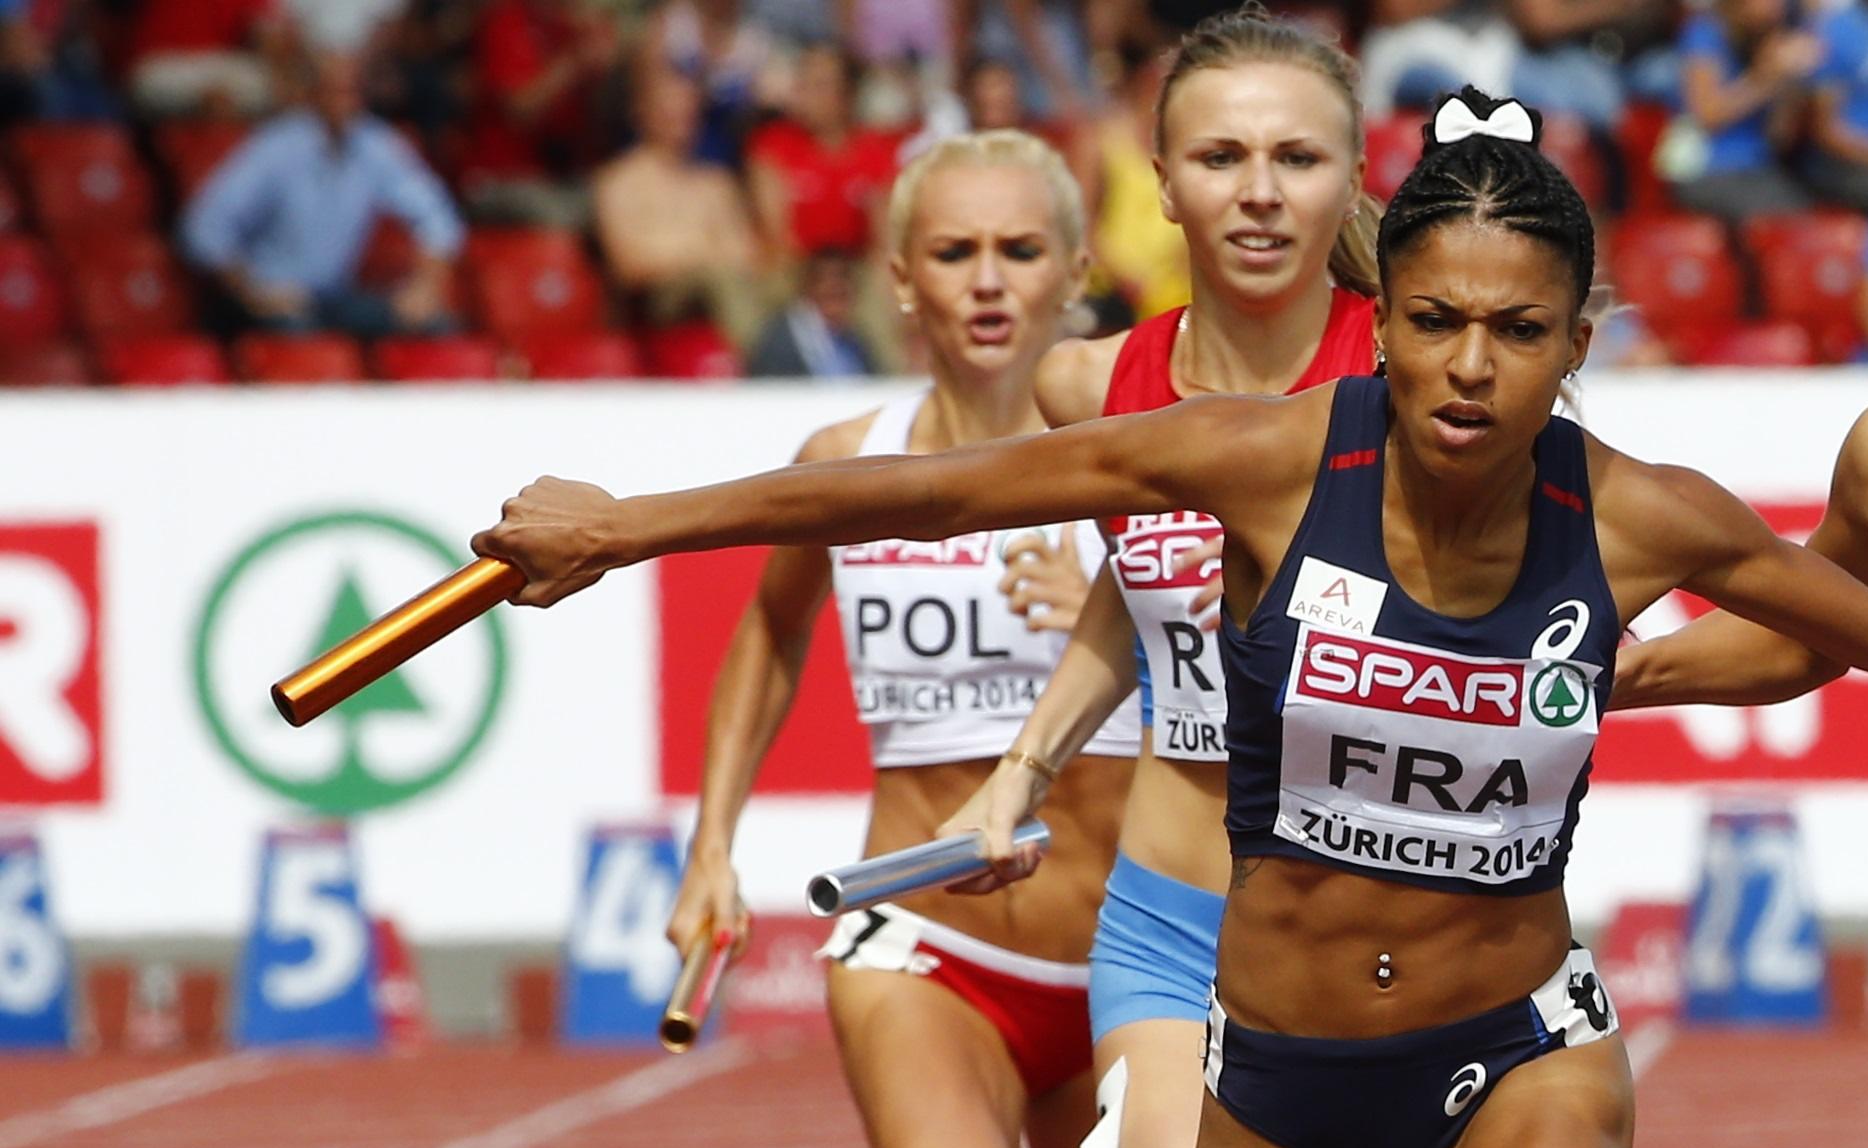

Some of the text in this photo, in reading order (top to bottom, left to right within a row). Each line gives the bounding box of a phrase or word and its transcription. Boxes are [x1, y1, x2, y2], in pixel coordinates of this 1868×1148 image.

[857, 596, 1009, 657] POL
[1294, 601, 1364, 634] AREVA
[1305, 642, 1518, 717] SPAR
[1329, 734, 1528, 813] FRA
[1300, 809, 1546, 877] ZÜRICH 2014
[258, 848, 370, 1011] 5
[574, 838, 684, 1004] 4
